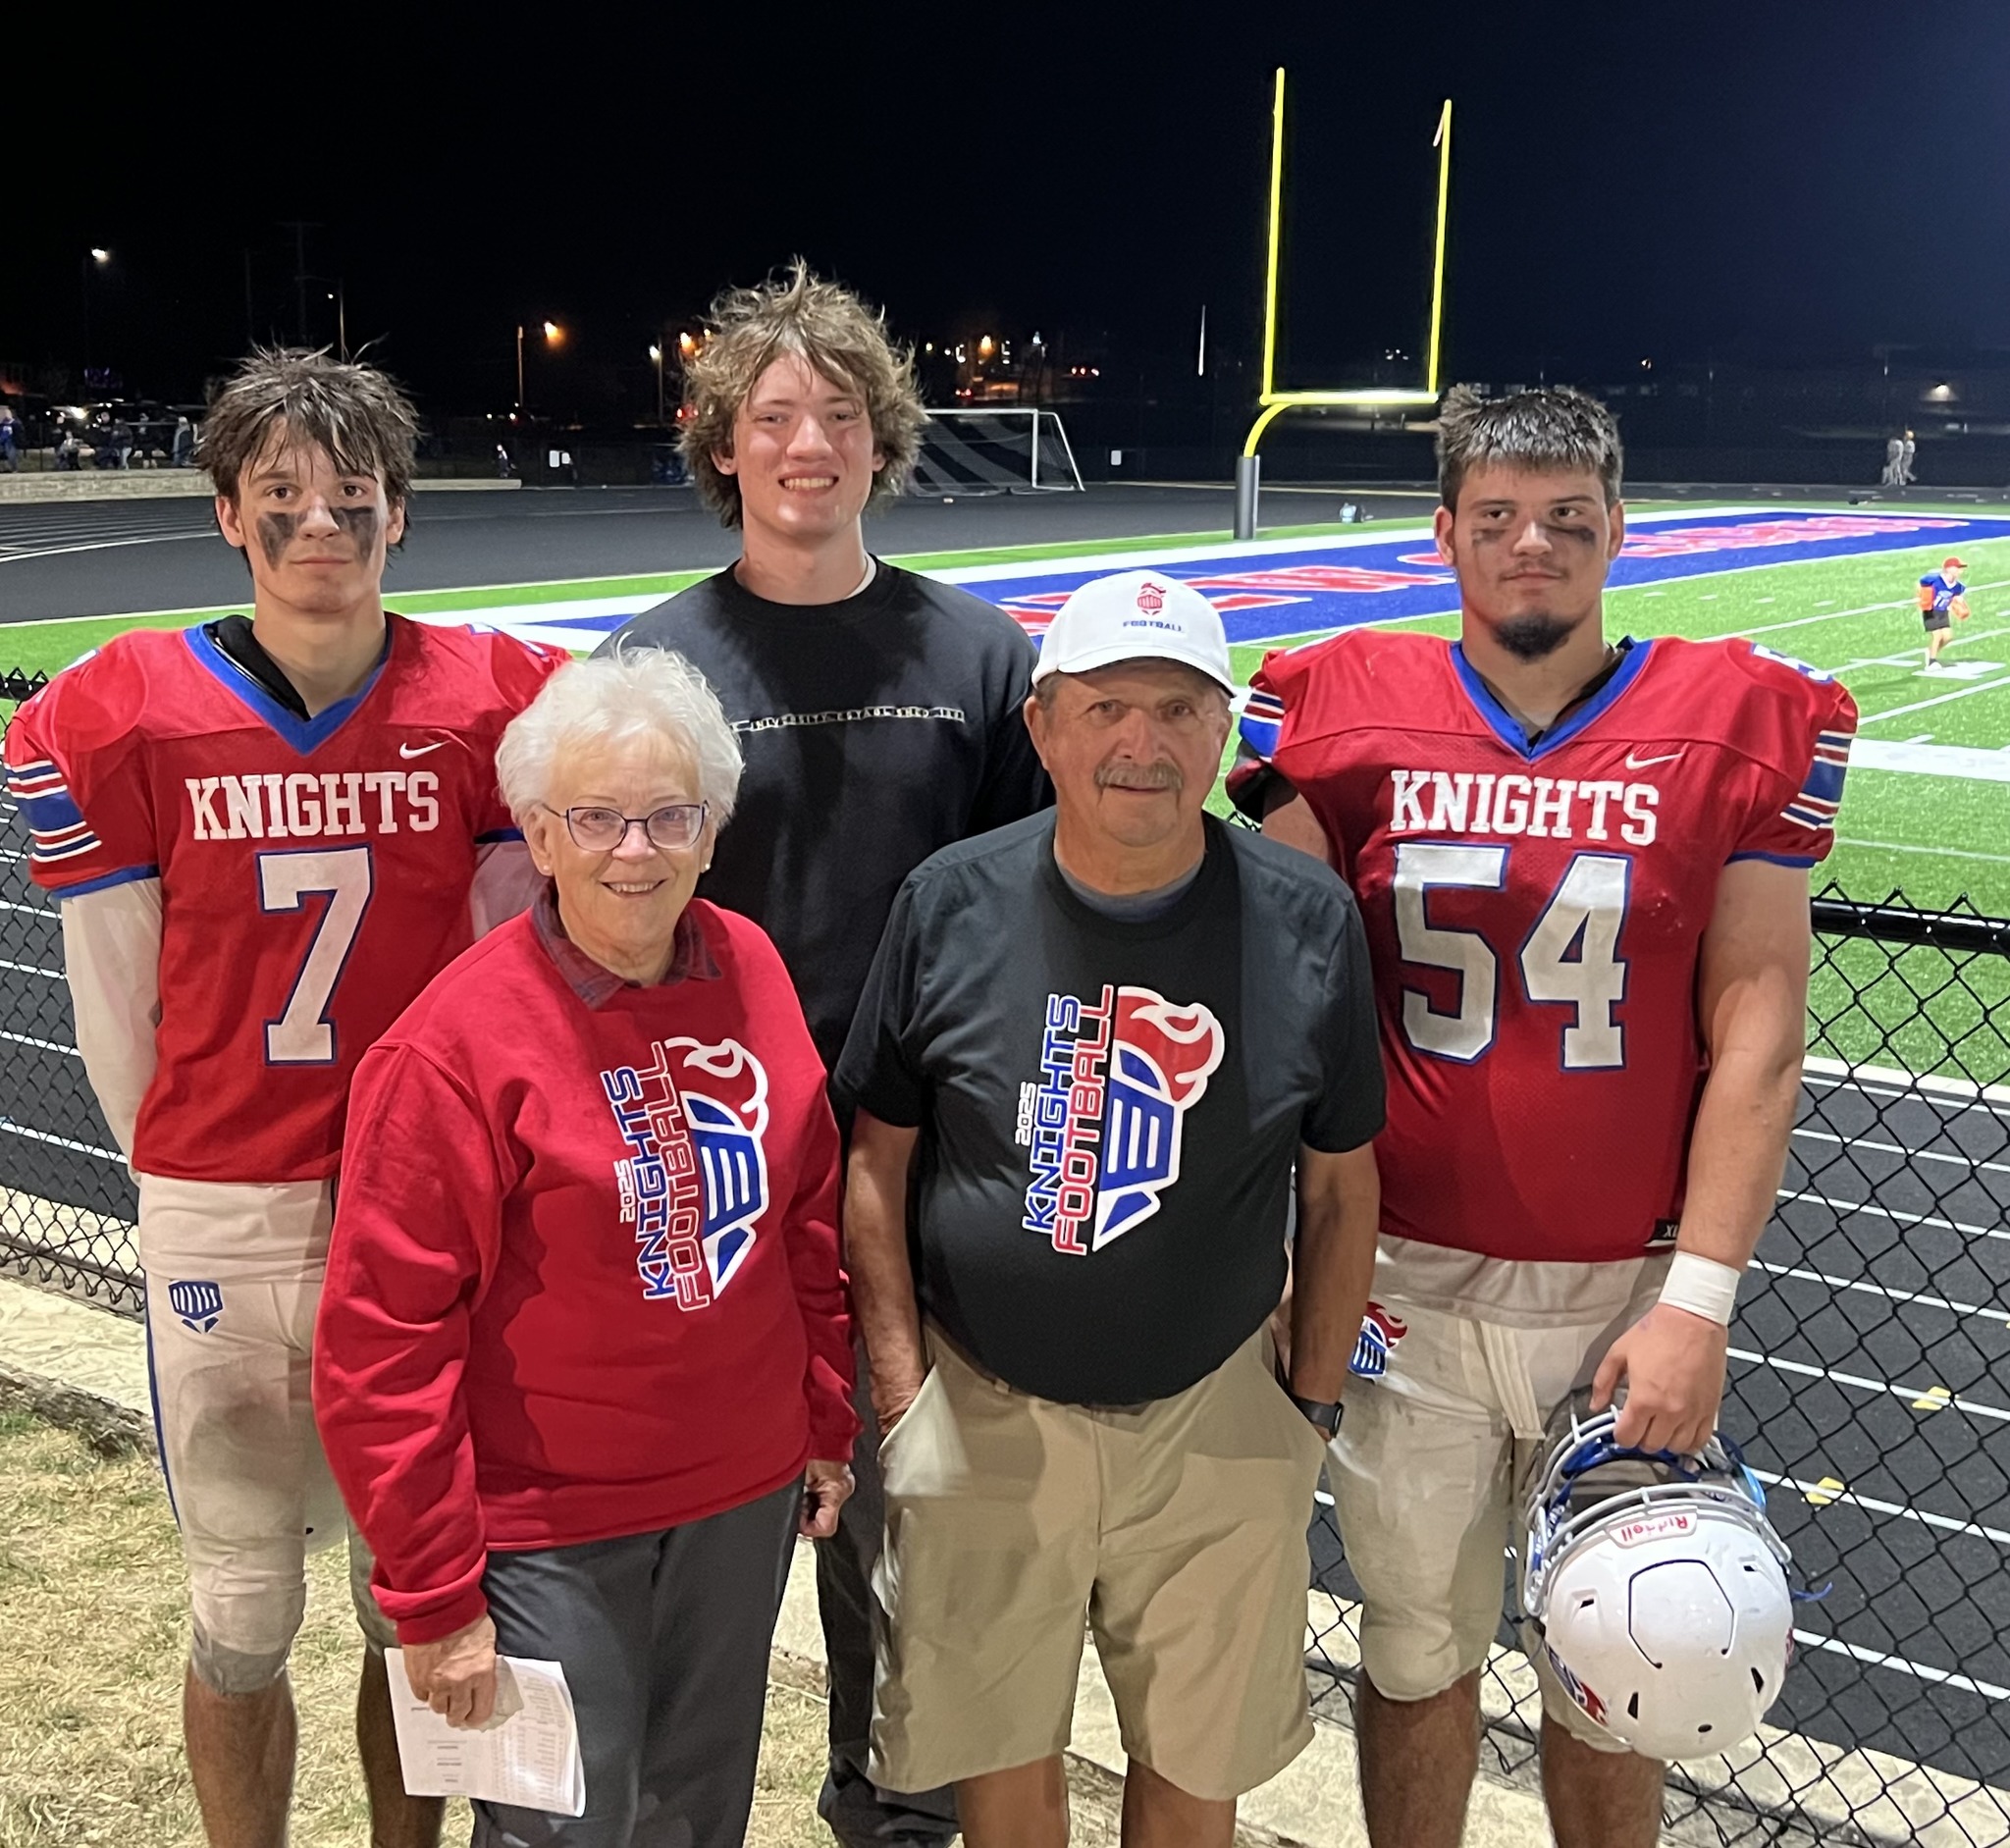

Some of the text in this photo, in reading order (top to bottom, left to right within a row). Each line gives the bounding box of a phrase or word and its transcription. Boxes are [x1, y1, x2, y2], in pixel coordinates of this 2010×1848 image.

[1123, 620, 1185, 633] FOOTBALL
[185, 771, 439, 840] KNIGHTS
[1391, 770, 1659, 846] KNIGHTS
[256, 843, 374, 1066] 7
[1393, 839, 1632, 1072] 54
[600, 1066, 677, 1299] KNIGHTS
[613, 1158, 636, 1223] 2025
[637, 1041, 710, 1311] FOOTBALL
[1015, 1082, 1036, 1145] 2025
[1022, 993, 1082, 1234] KNIGHTS
[1051, 984, 1114, 1255] FOOTBALL
